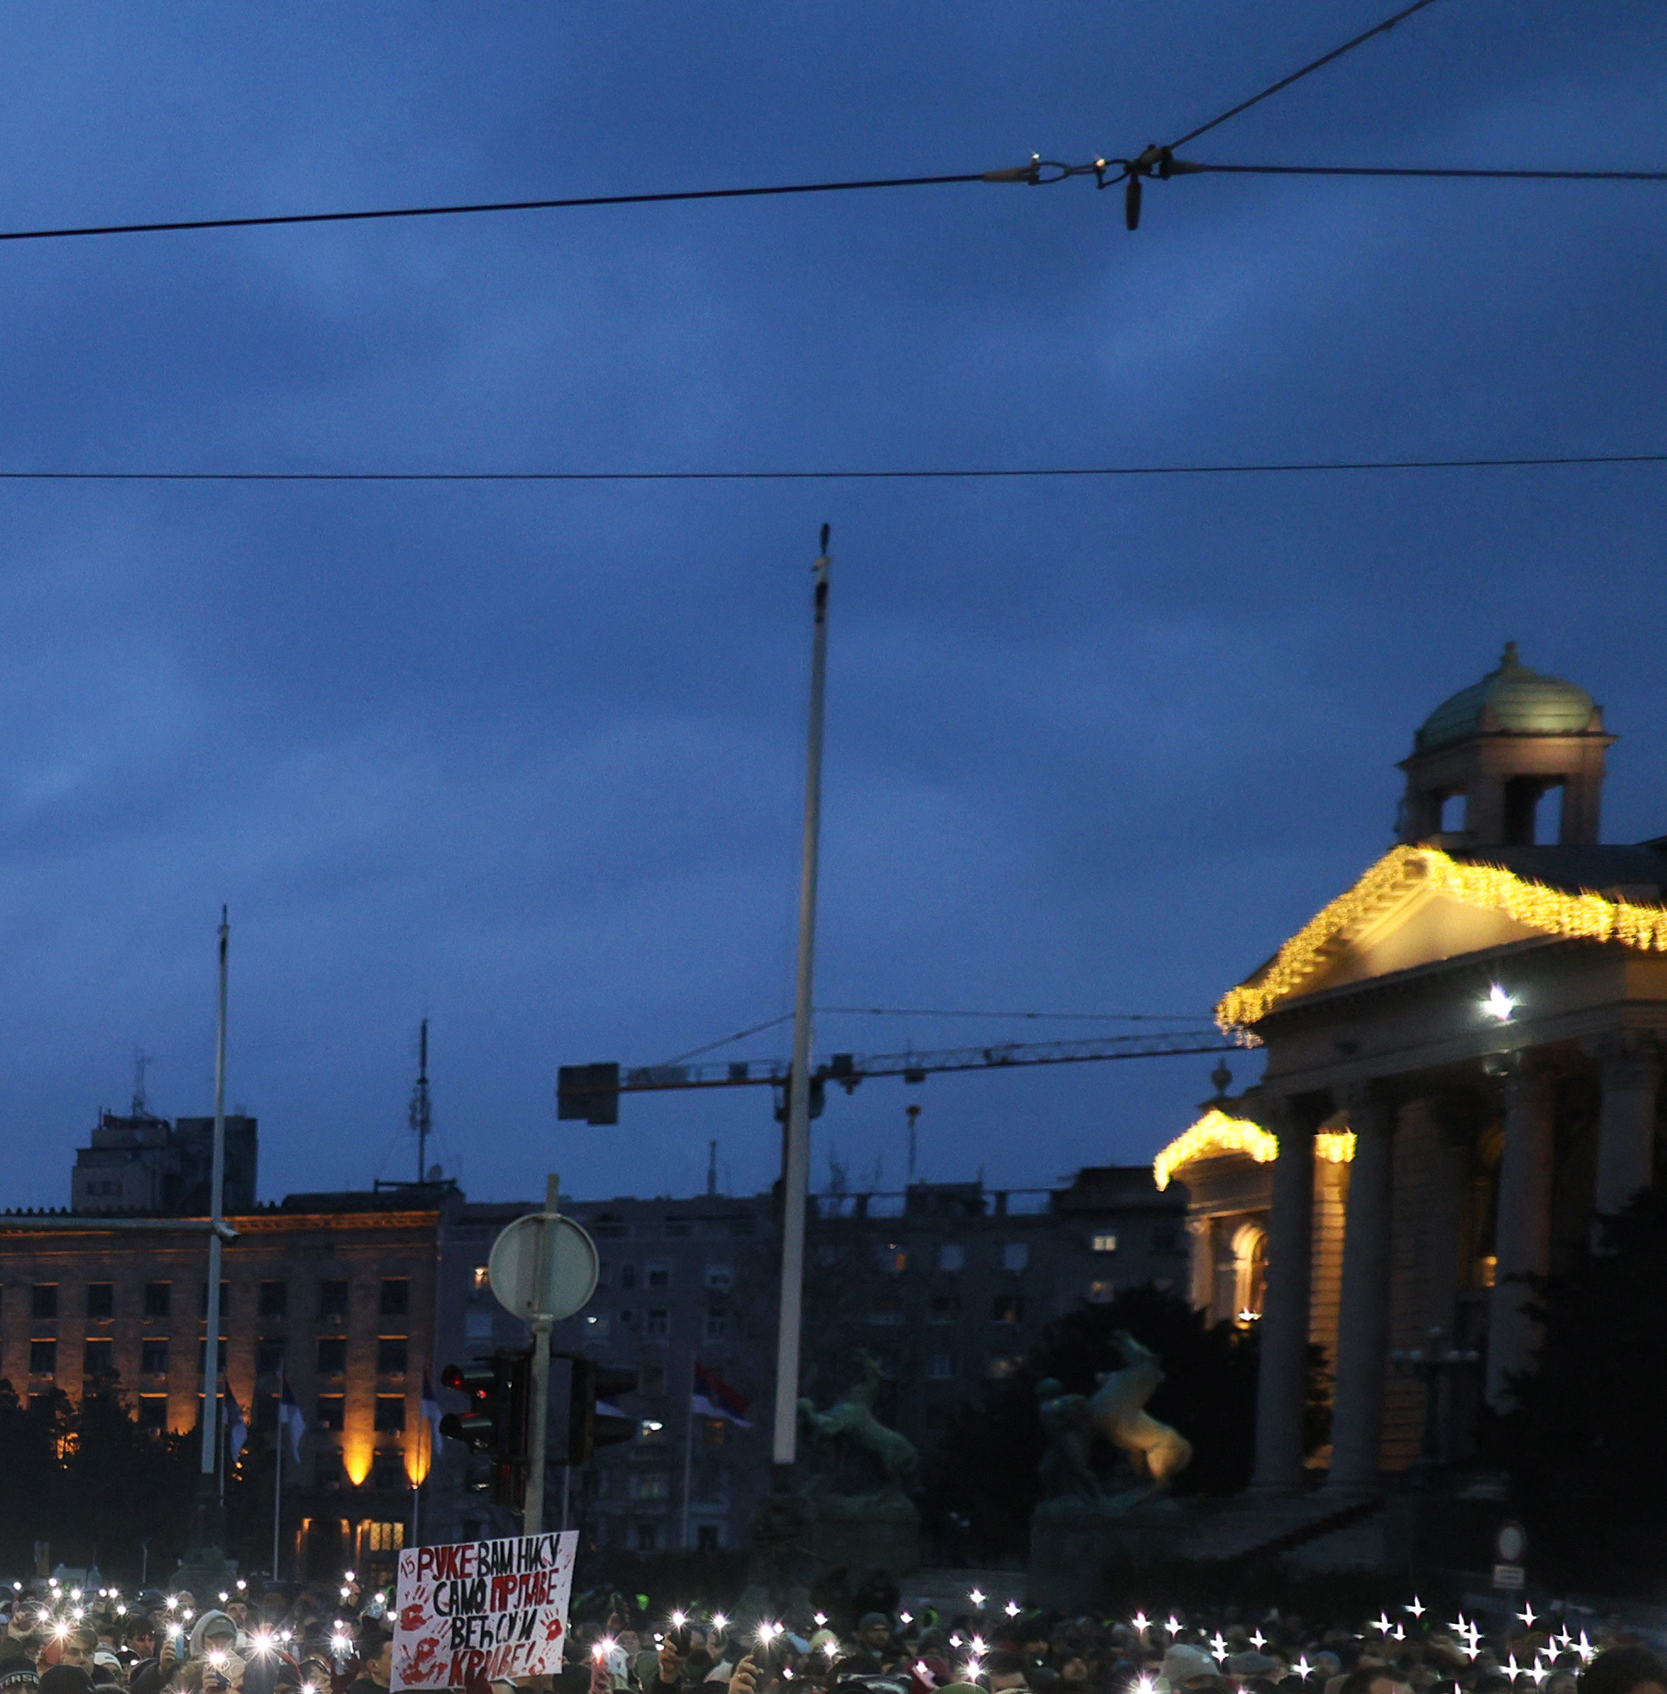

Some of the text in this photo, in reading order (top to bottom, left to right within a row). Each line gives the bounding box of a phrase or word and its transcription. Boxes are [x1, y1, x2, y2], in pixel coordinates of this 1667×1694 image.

[417, 1533, 561, 1582] РУКЕ ВАМ НИСУ
[433, 1577, 487, 1617] САМО
[450, 1615, 494, 1650] ВЕЋ
